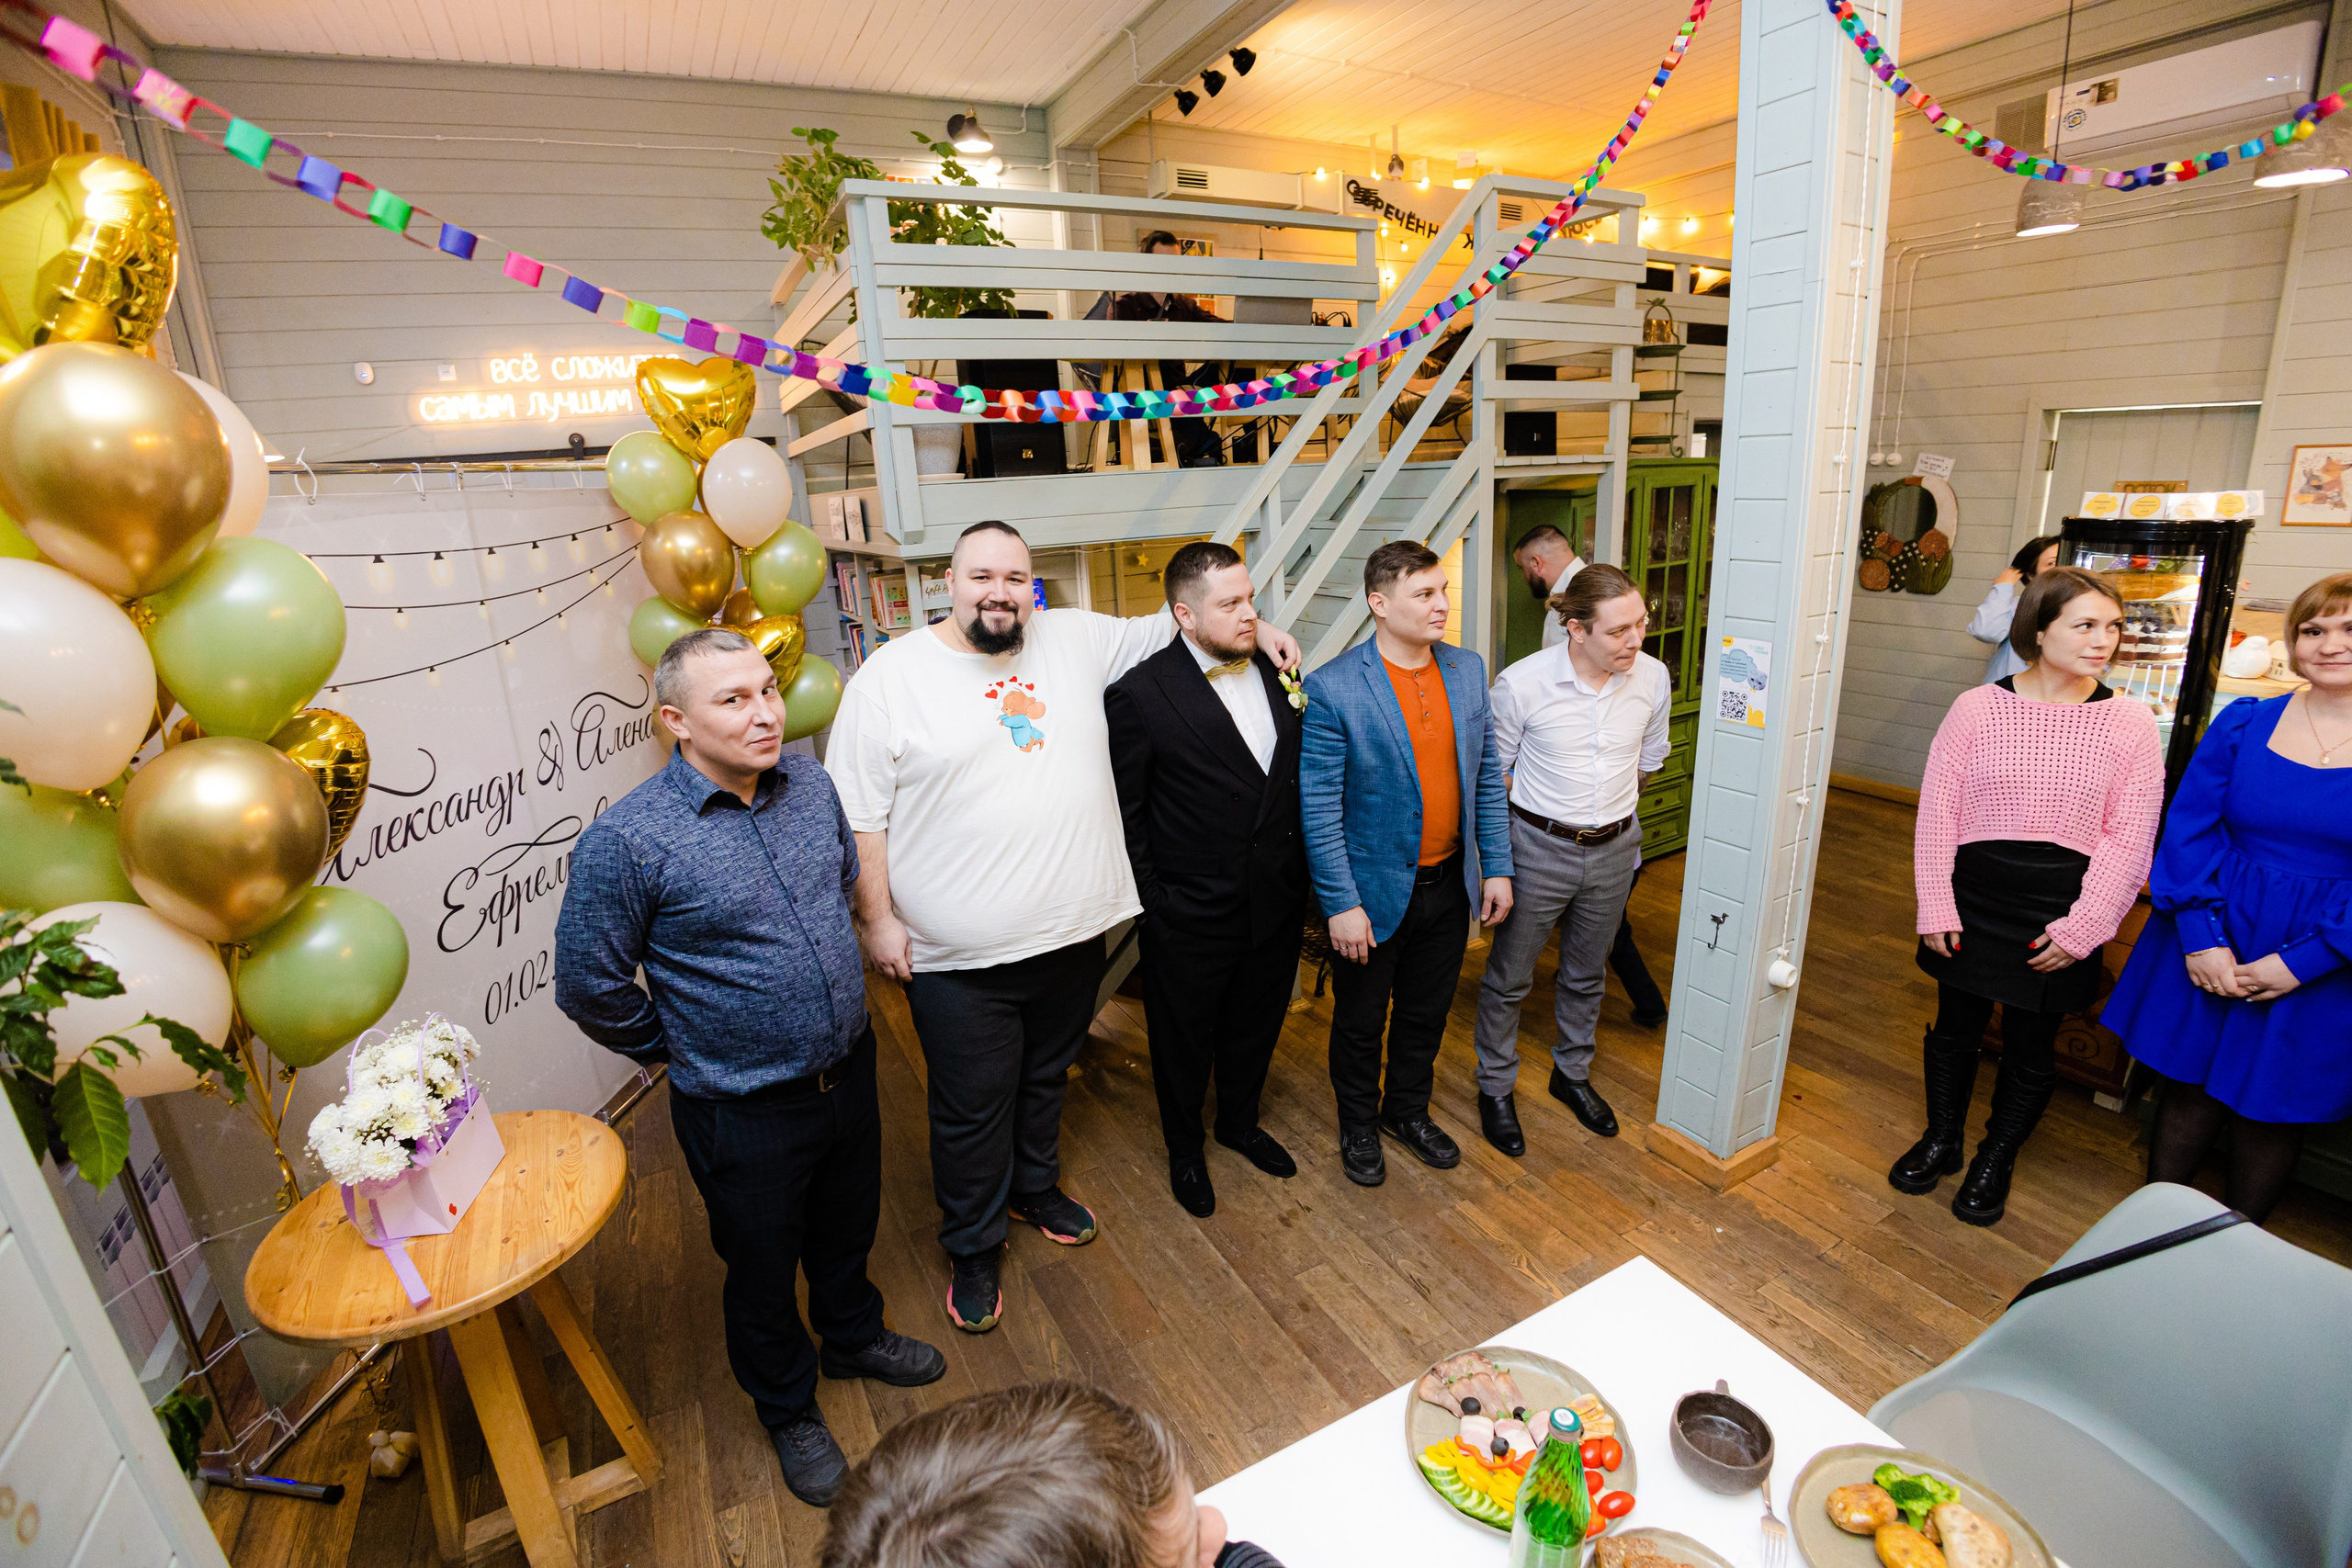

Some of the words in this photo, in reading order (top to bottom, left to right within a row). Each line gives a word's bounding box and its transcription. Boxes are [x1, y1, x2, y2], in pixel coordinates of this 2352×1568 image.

[552, 354, 680, 380] сложи
[437, 796, 607, 953] Ефрем
[484, 950, 555, 1024] 01.02.
